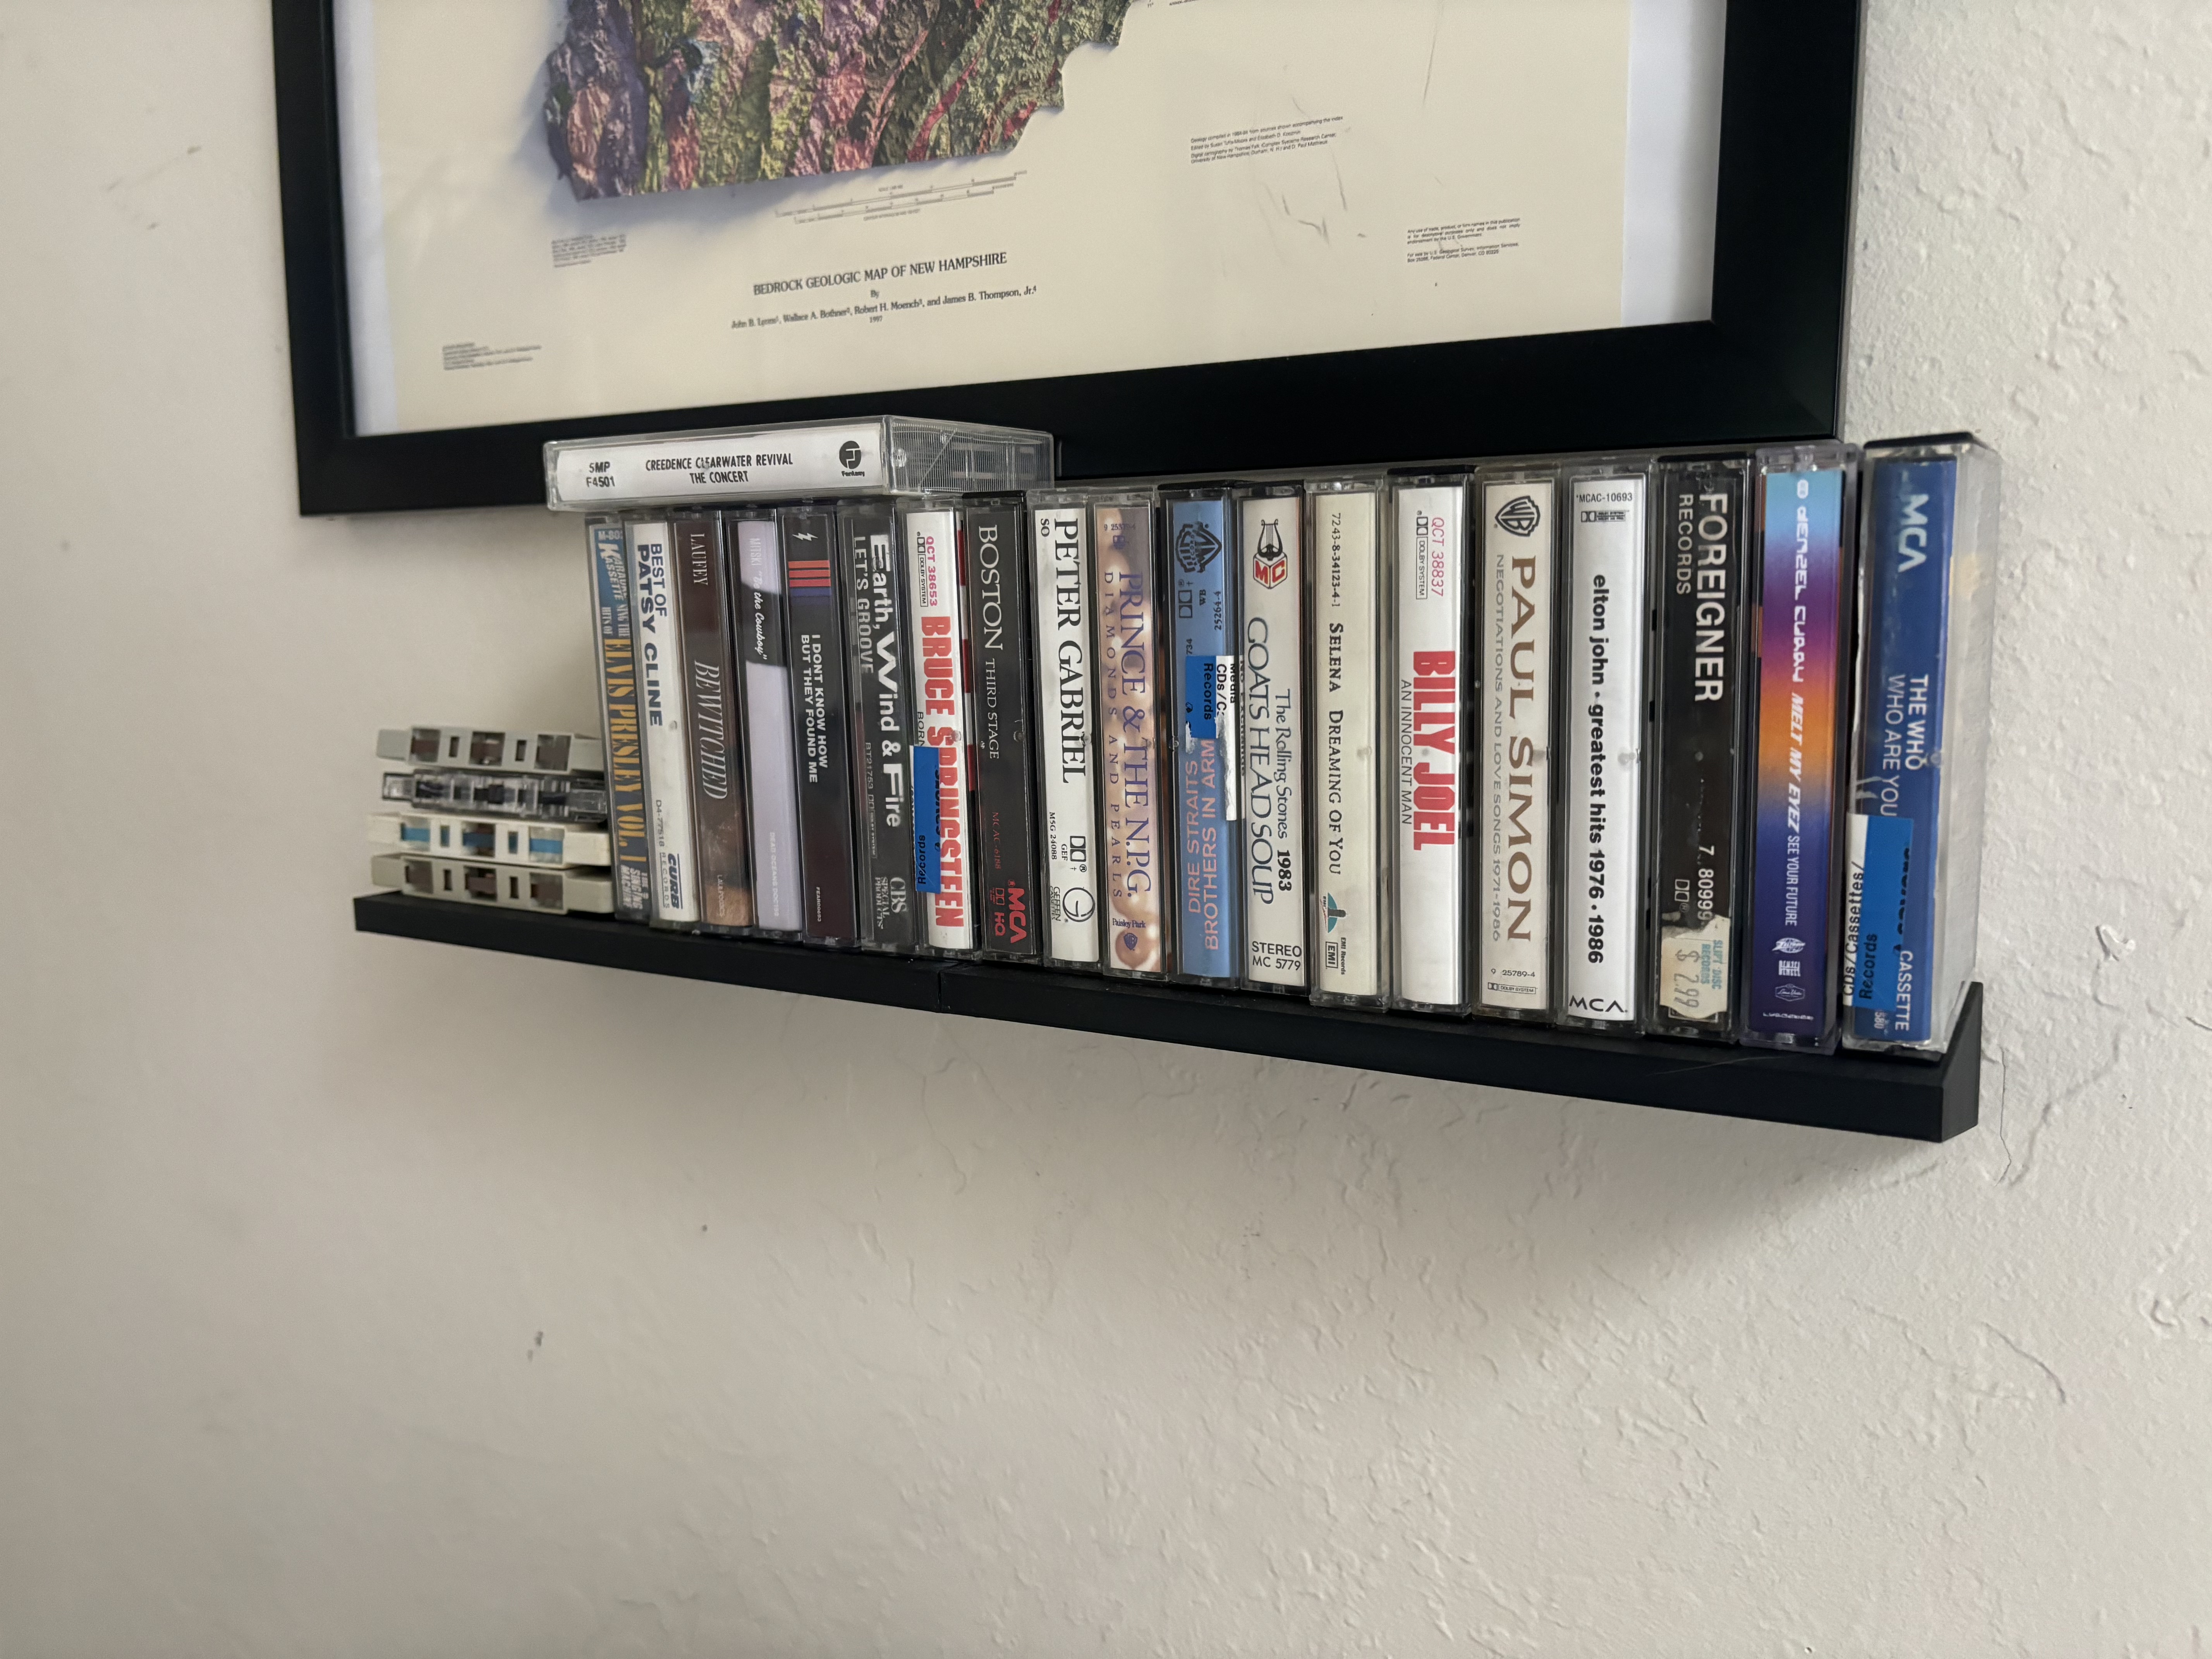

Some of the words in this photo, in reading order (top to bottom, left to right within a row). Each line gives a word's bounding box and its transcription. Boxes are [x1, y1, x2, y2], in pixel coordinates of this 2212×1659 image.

[754, 278, 803, 295] BEDROCK
[806, 271, 861, 289] GEOLOGIC
[864, 268, 888, 281] MAP
[891, 266, 907, 278] OF
[910, 262, 935, 276] NEW
[939, 252, 1007, 273] HAMPSHIRE
[871, 290, 879, 299] By
[783, 312, 808, 323] Wallace
[854, 304, 878, 315] Robert
[927, 297, 940, 306] and
[943, 294, 966, 305] James
[968, 293, 976, 302] B.
[978, 289, 1022, 301] Thompson,
[646, 458, 692, 471] CREEDENCE
[696, 455, 752, 469] CLEARWATER
[756, 452, 793, 466] REVIVAL
[690, 472, 706, 484] THE
[709, 470, 749, 483] CONCERT
[749, 538, 762, 566] MITSKI
[926, 536, 936, 563] QCT
[1040, 517, 1050, 537] SO
[1432, 517, 1445, 546] QCT
[1676, 493, 1693, 594] RECORDS
[1898, 493, 1929, 572] MCA
[651, 544, 665, 589] BEST
[690, 533, 708, 585] LAUFEY
[854, 536, 869, 591] LET'S
[870, 534, 894, 630] Earth,
[1054, 518, 1082, 631] PETER
[1431, 550, 1445, 596] 38837
[637, 544, 656, 634] PATSY
[654, 593, 667, 617] OF
[754, 592, 763, 610] the
[928, 566, 938, 607] 38653
[978, 524, 1003, 651] BOSTON
[1199, 589, 1207, 605] WB
[1214, 590, 1223, 631] 25264-4
[1592, 574, 1610, 631] elton
[1695, 493, 1728, 702] FOREIGNER
[857, 598, 874, 674] GROOVE
[1119, 571, 1146, 696] PRINCE
[1494, 554, 1505, 692] NEGOTIATIONS
[1509, 555, 1536, 720] PAUL
[605, 639, 635, 697] ELVIS
[801, 634, 812, 663] BUT
[812, 641, 823, 684] DONT
[921, 616, 955, 715] BRUCE
[1247, 617, 1271, 721] GOATS
[1329, 623, 1344, 692] SELENA
[1589, 636, 1609, 686] john
[644, 642, 663, 726] CLINE
[804, 667, 813, 704] THEY
[876, 631, 900, 732] Wind
[985, 658, 997, 708] THIRD
[1203, 663, 1214, 721] Records
[1275, 688, 1291, 723] The
[1401, 679, 1412, 702] AN
[1413, 651, 1456, 755] BILLY
[1885, 674, 1906, 725] WHO
[1908, 674, 1929, 716] THE
[694, 659, 728, 799] BEWITCHED
[806, 709, 816, 757] FOUND
[815, 685, 826, 731] KNOW
[1058, 640, 1086, 784] GABRIEL
[1122, 705, 1146, 734] &
[1494, 697, 1503, 738] AND
[1790, 692, 1804, 747] MELT
[609, 704, 641, 792] PRESLEY
[817, 733, 828, 768] HOW
[881, 740, 901, 757] &
[987, 712, 1000, 759] STAGE
[1108, 734, 1120, 785] AND
[1274, 726, 1293, 783] Rolling
[1328, 710, 1343, 804] DREAMING
[1400, 706, 1412, 786] INNOCENT
[1588, 703, 1607, 798] greatest
[1882, 729, 1902, 771] ARE
[1905, 720, 1927, 770] WHO
[808, 761, 818, 783] ME
[1123, 742, 1149, 809] THE
[1249, 725, 1273, 819] HEAD
[1493, 743, 1502, 790] LOVE
[1789, 747, 1802, 783] MY
[883, 763, 905, 828] Fire
[1186, 760, 1200, 856] STRAITS
[1200, 797, 1217, 819] IN
[1276, 786, 1292, 840] Stones
[1401, 791, 1412, 825] MAN
[1413, 762, 1455, 851] JOEL
[1787, 782, 1801, 835] EYEZ
[1880, 775, 1900, 817] YOU
[617, 803, 645, 847] VOL.
[1328, 809, 1343, 833] OF
[1493, 795, 1501, 855] SONGS
[1508, 736, 1535, 942] SIMON
[1589, 802, 1606, 844] hits
[1787, 835, 1800, 855] SEE
[917, 835, 926, 885] Records
[1111, 803, 1123, 898] PEARLS
[1125, 817, 1152, 898] N.P.G.
[1251, 822, 1274, 905] SOUP
[1277, 849, 1292, 892] 1983
[1328, 837, 1343, 876] YOU
[1588, 848, 1606, 900] 1976
[1786, 855, 1800, 884] YOUR
[630, 867, 644, 910] SINGING
[668, 853, 680, 909] CURB
[875, 876, 884, 929] PRODUCTS
[881, 876, 890, 918] SPECIAL
[890, 876, 907, 914] CBS
[1053, 886, 1061, 922] GEFFEN
[1188, 864, 1202, 914] DIRE
[1202, 827, 1219, 951] BROTHERS
[1492, 859, 1501, 941] 1971-1986
[1008, 887, 1027, 944] MCA
[1112, 917, 1132, 929] Paisley
[1131, 919, 1146, 929] Park
[1785, 887, 1799, 927] FUTURE
[1251, 941, 1302, 957] STEREO
[1252, 956, 1271, 968] MC
[1275, 958, 1301, 971] 5779
[1328, 944, 1336, 965] EMI
[1588, 915, 1605, 964] 1986
[1675, 949, 1700, 963] $
[1501, 969, 1536, 978] 25789-4
[1673, 972, 1700, 1009] 2.99
[1858, 933, 1878, 1000] Records
[1896, 950, 1913, 1032] CASSETTE
